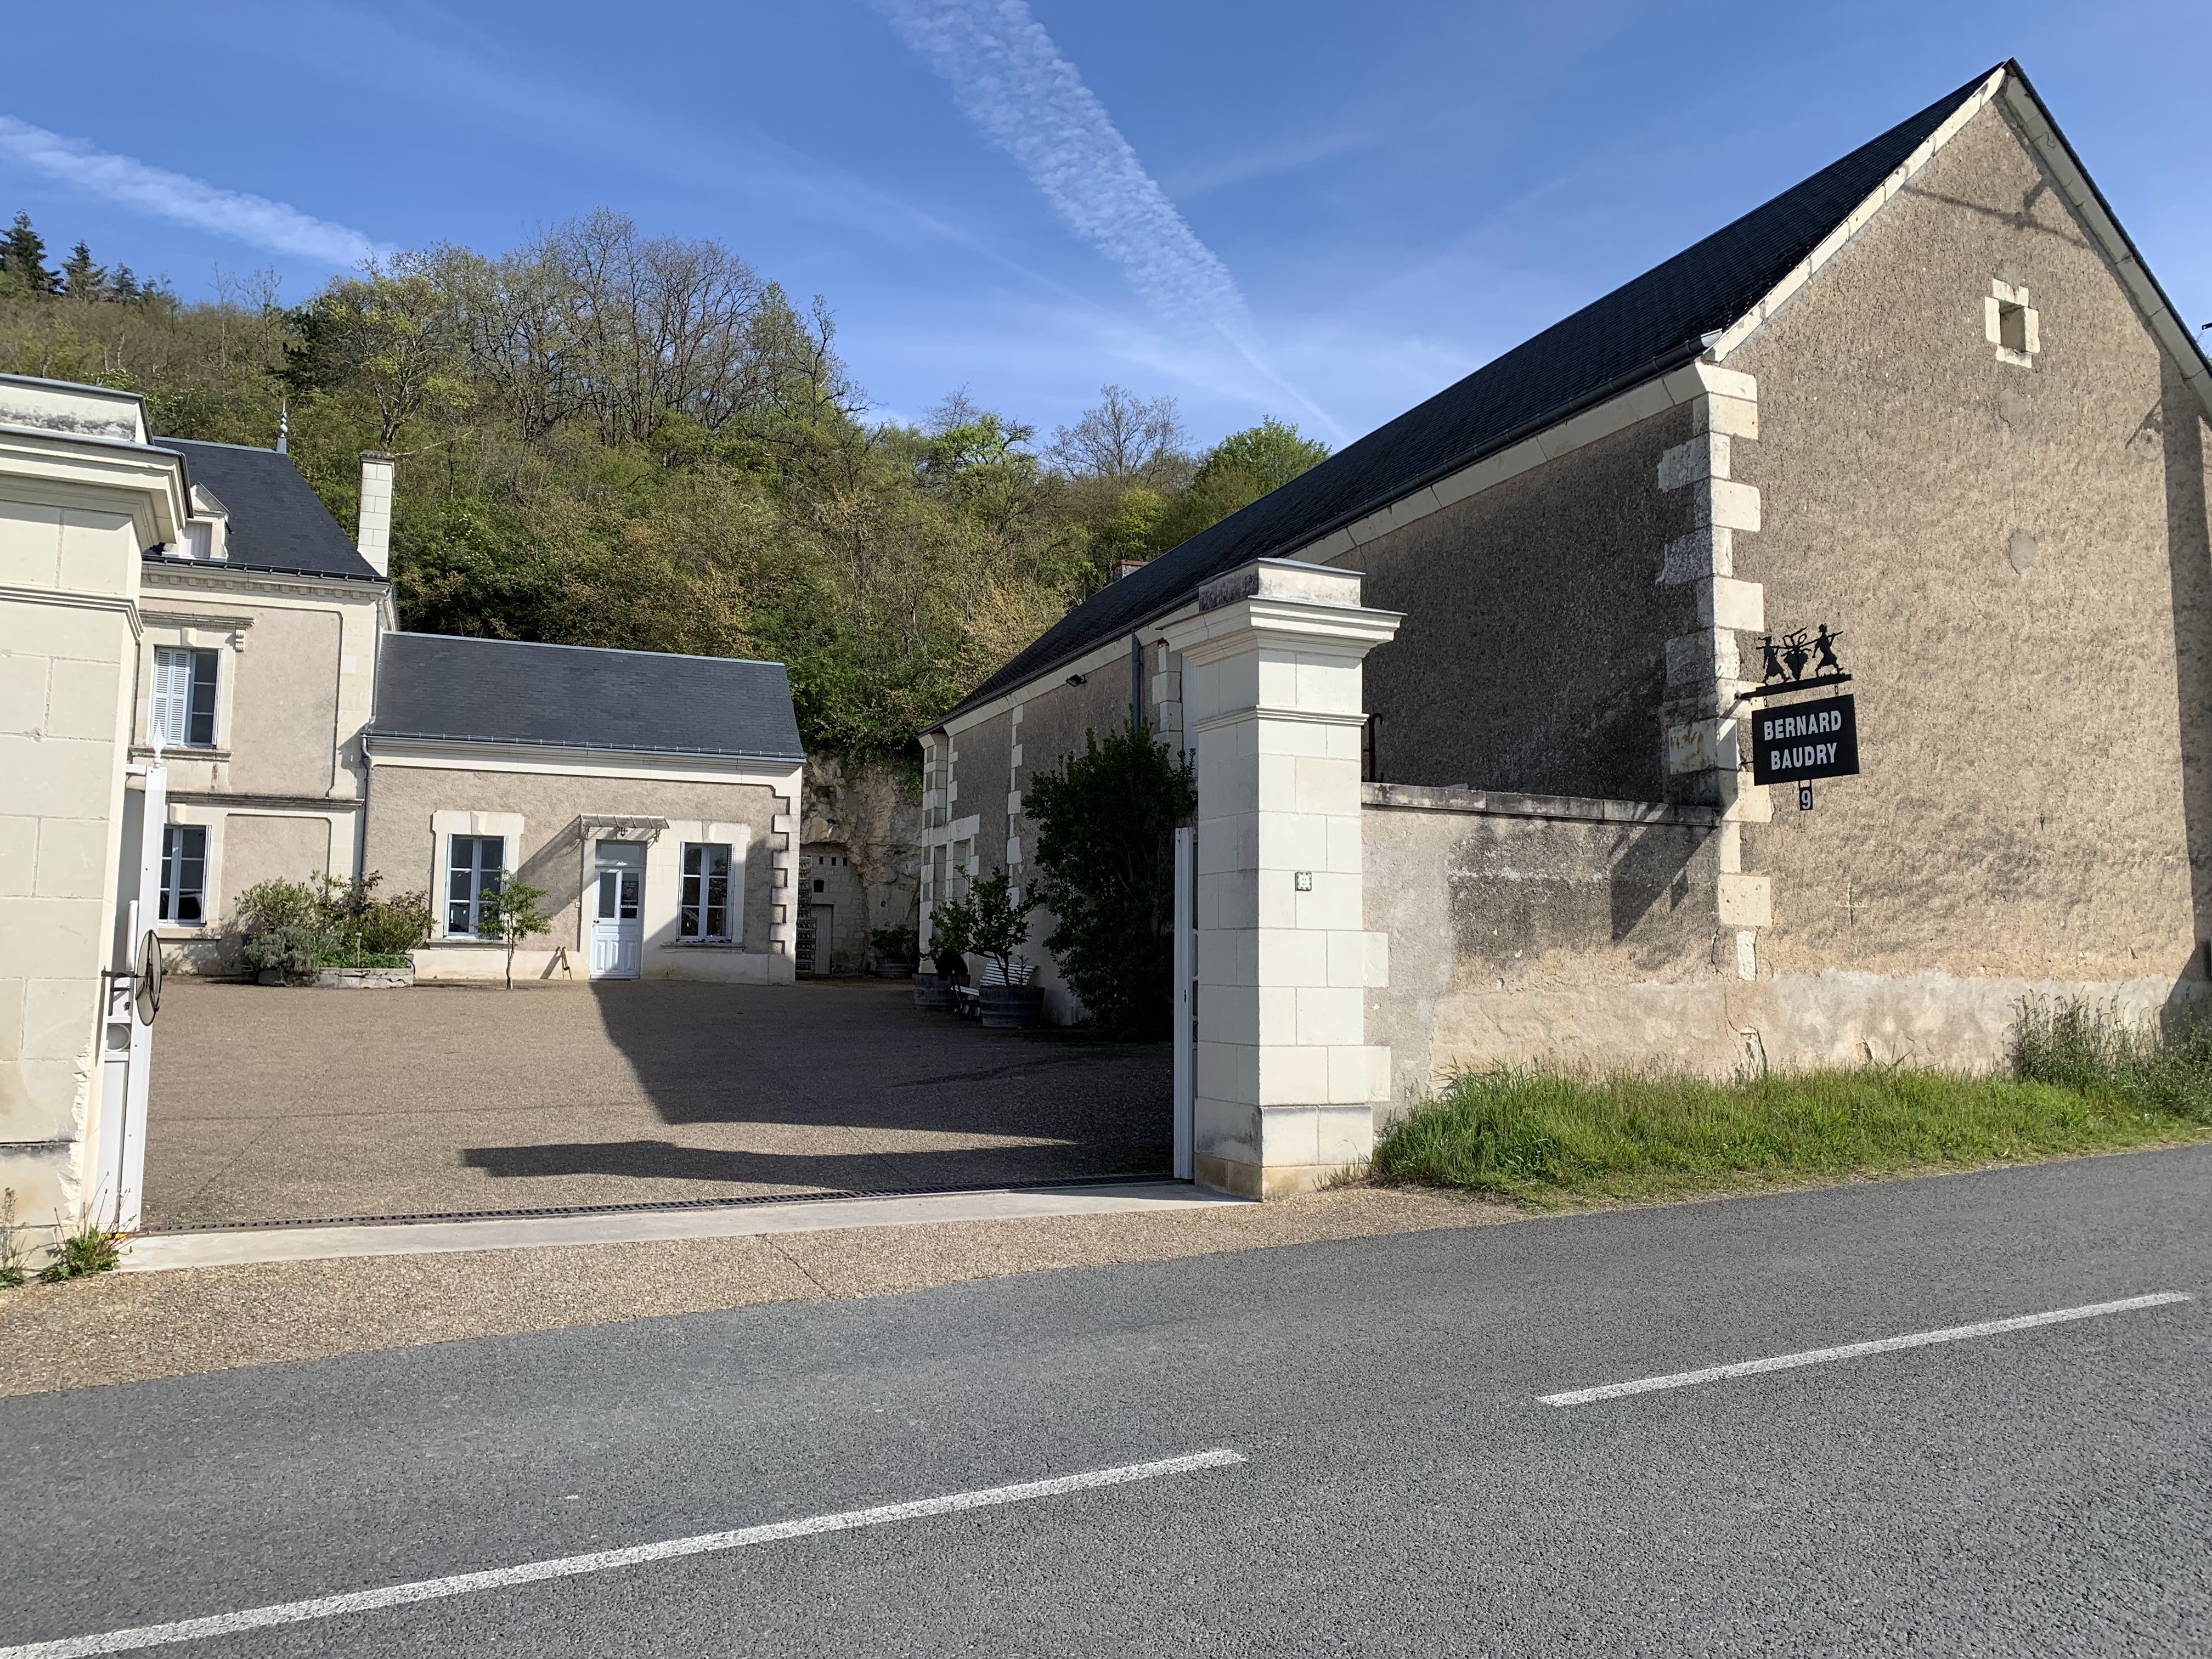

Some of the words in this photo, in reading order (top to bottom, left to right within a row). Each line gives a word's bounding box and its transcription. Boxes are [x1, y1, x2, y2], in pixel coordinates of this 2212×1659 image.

[1764, 710, 1842, 741] BERNARD
[1771, 742, 1837, 770] BAUDRY
[1801, 789, 1811, 810] 9
